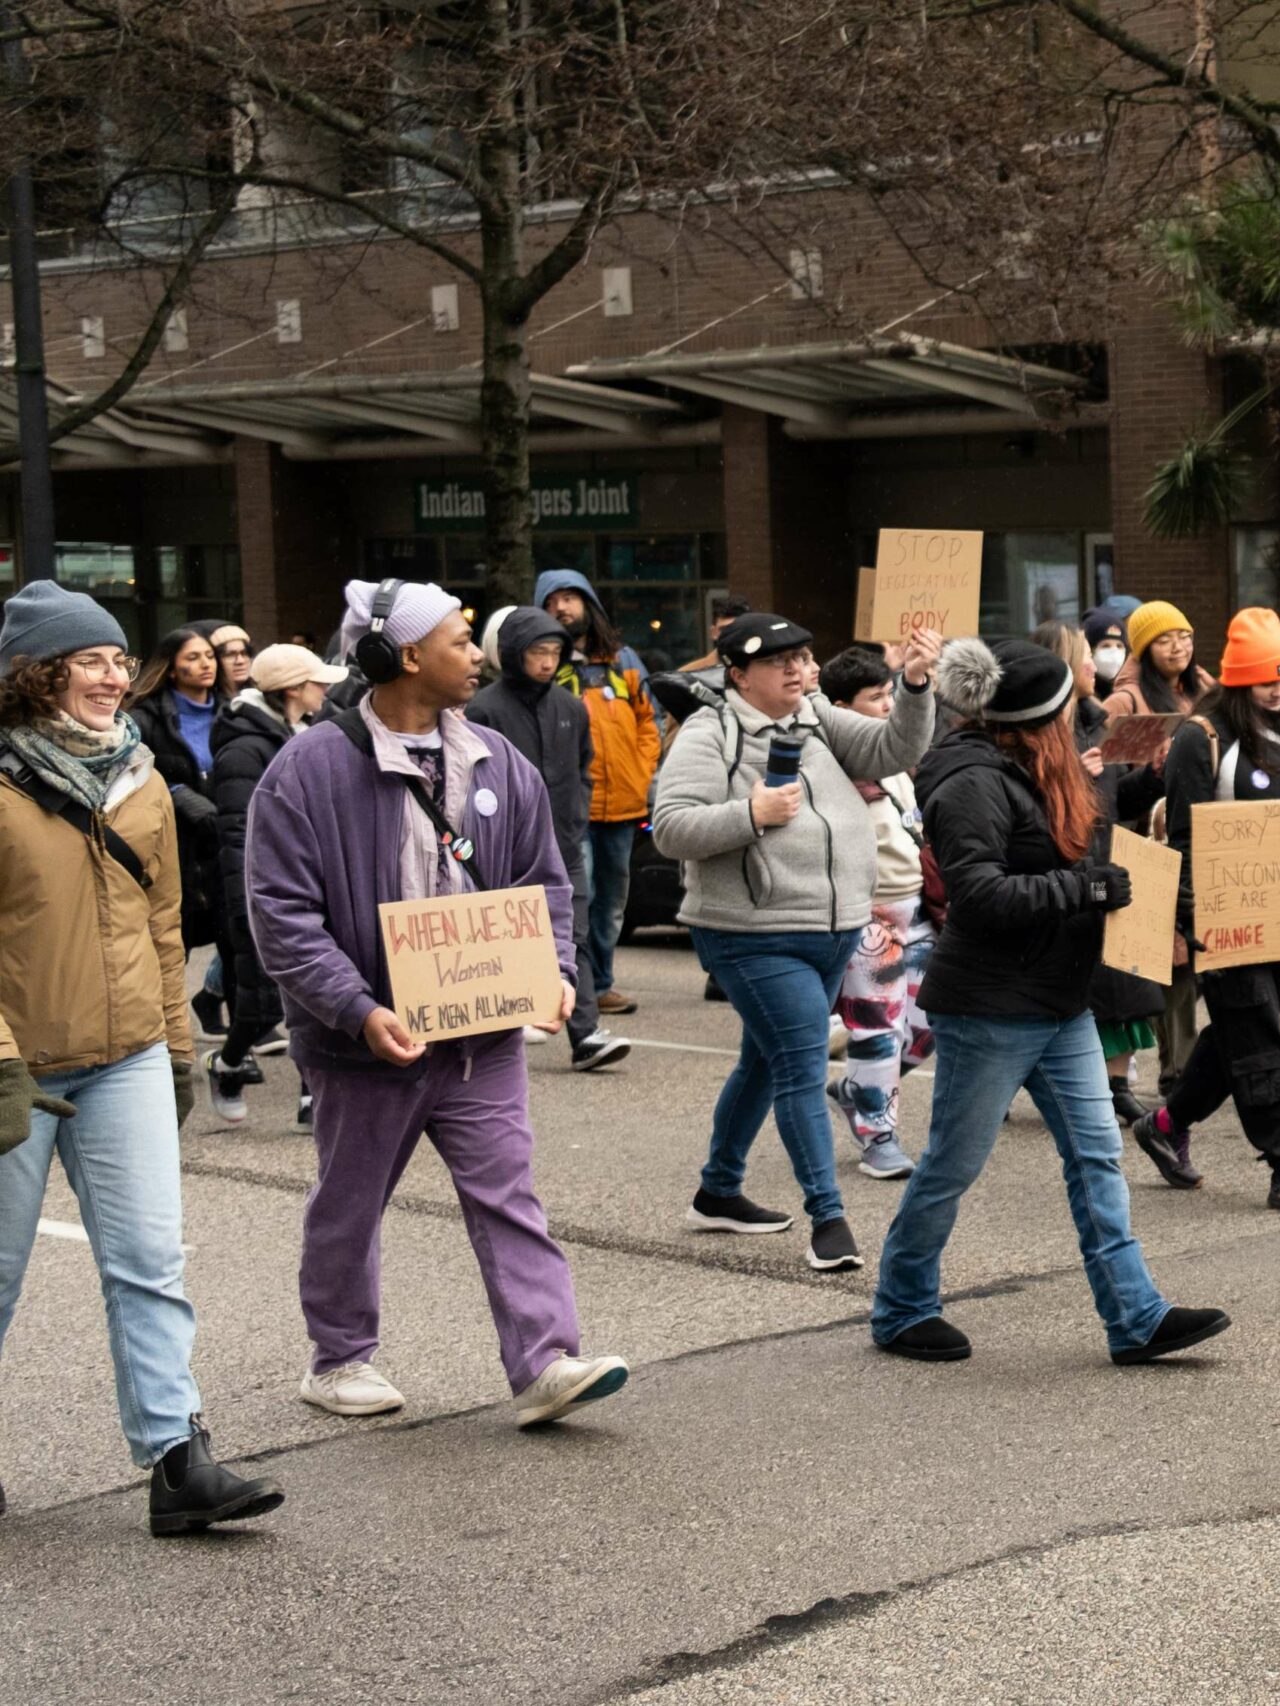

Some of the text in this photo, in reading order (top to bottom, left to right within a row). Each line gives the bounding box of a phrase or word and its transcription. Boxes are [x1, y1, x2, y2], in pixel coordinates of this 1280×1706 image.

[420, 479, 630, 524] Indian gers Joint
[894, 531, 963, 568] STOP
[909, 592, 938, 609] MY
[899, 608, 950, 636] BODY
[1209, 819, 1268, 846] SORRY
[1202, 892, 1227, 914] WE
[1240, 891, 1268, 908] ARE
[387, 899, 546, 956] WHEN WE SAY
[1203, 923, 1265, 953] CHANGE
[405, 993, 535, 1034] WE MEAN ALL WOMEN
